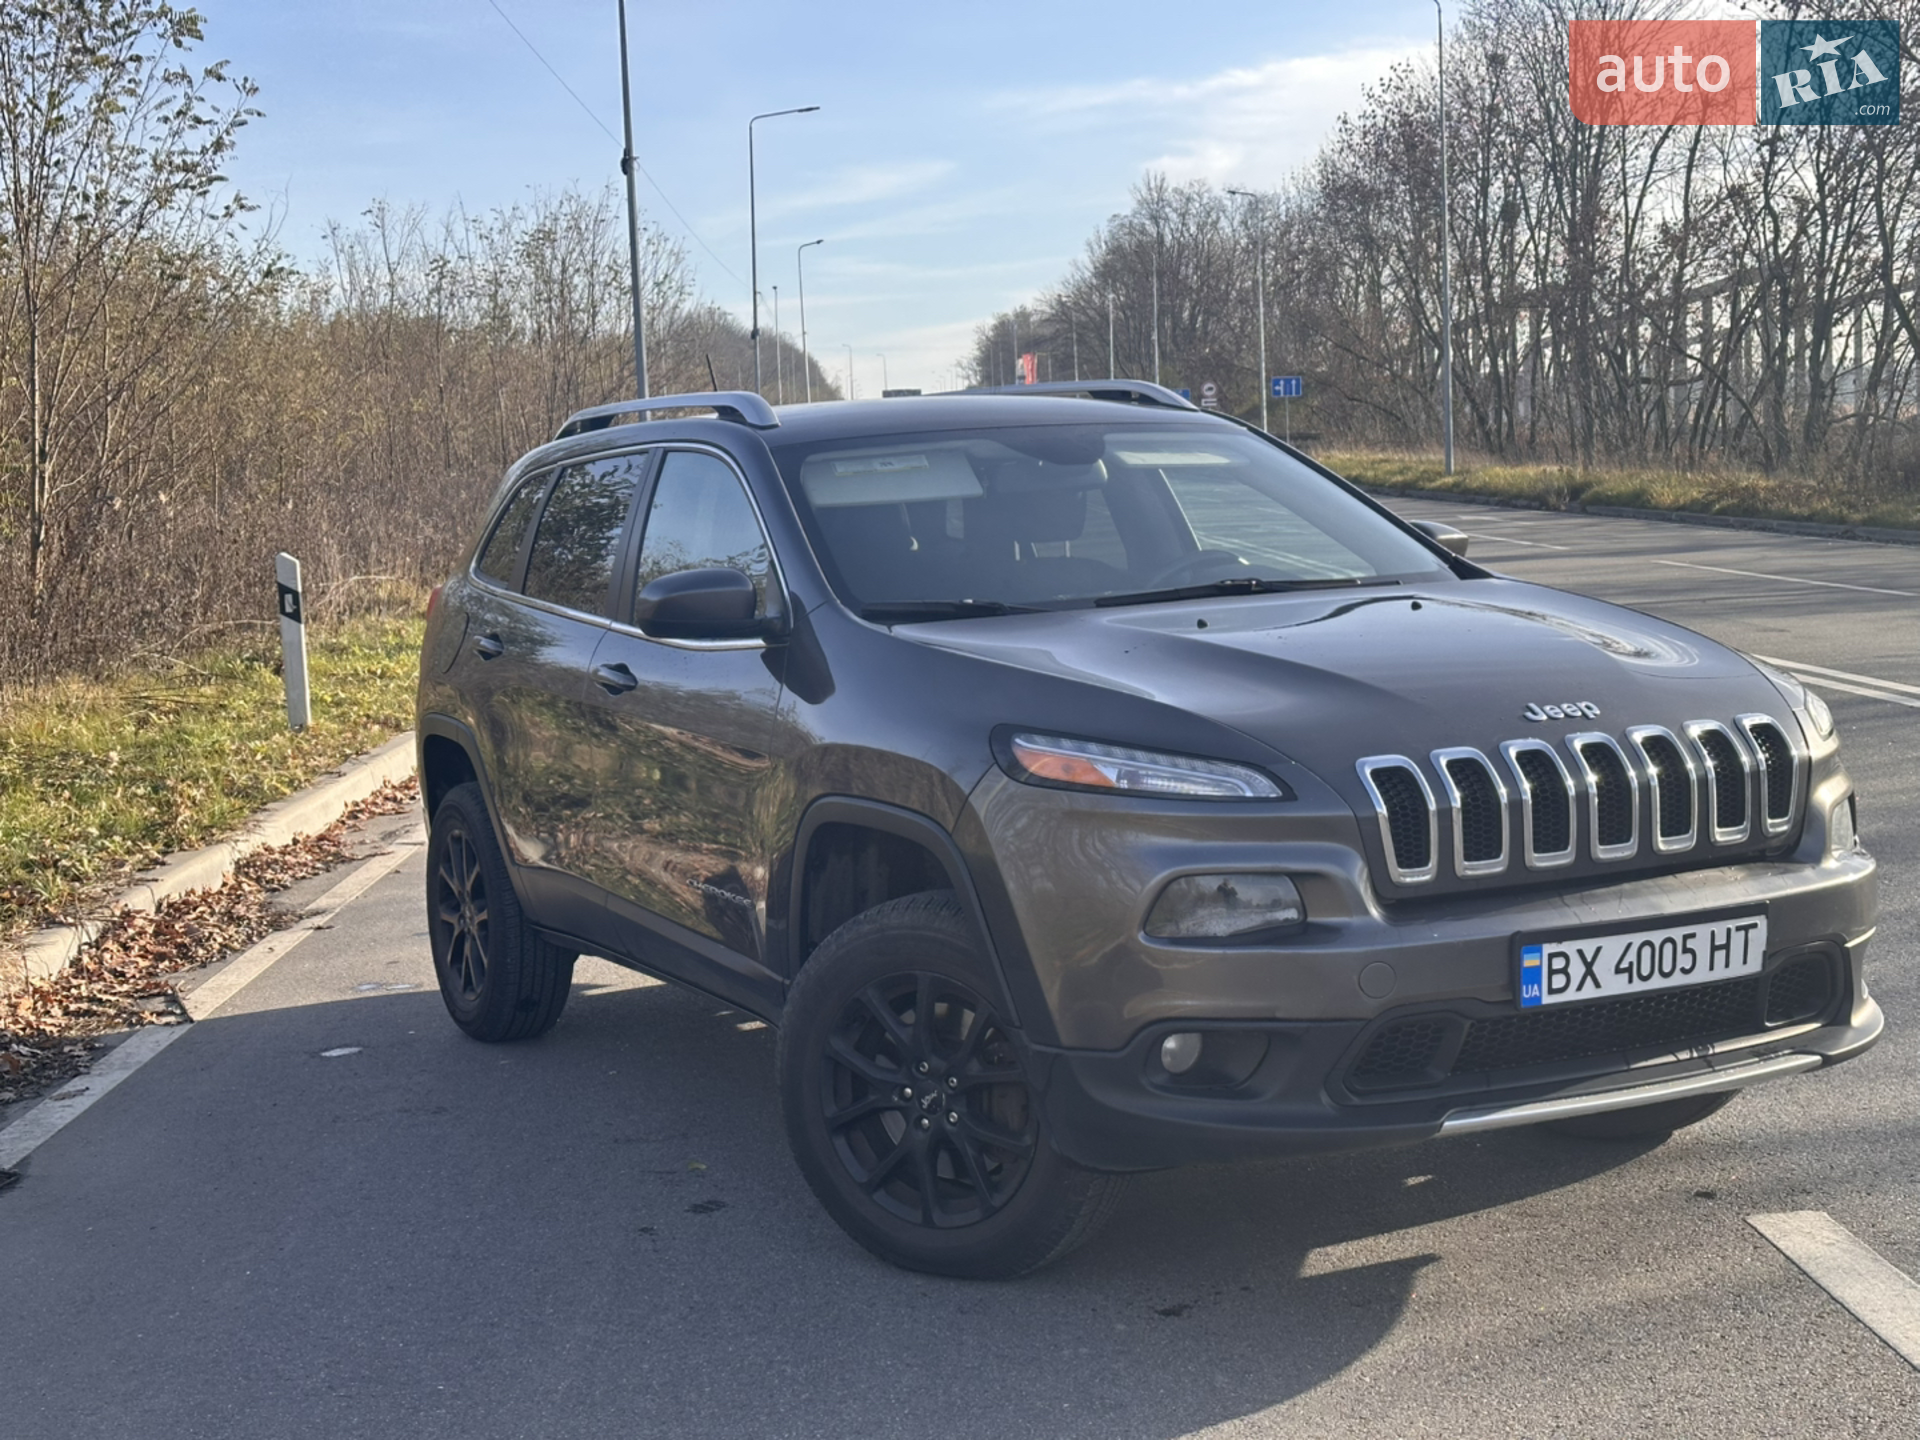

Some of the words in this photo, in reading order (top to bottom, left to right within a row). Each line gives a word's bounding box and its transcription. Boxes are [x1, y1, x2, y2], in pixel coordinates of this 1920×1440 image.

[1523, 701, 1601, 721] Jeep
[1547, 946, 1603, 995] BX
[1614, 932, 1697, 984] 4005
[1708, 920, 1760, 971] HT
[1522, 984, 1541, 998] UA
